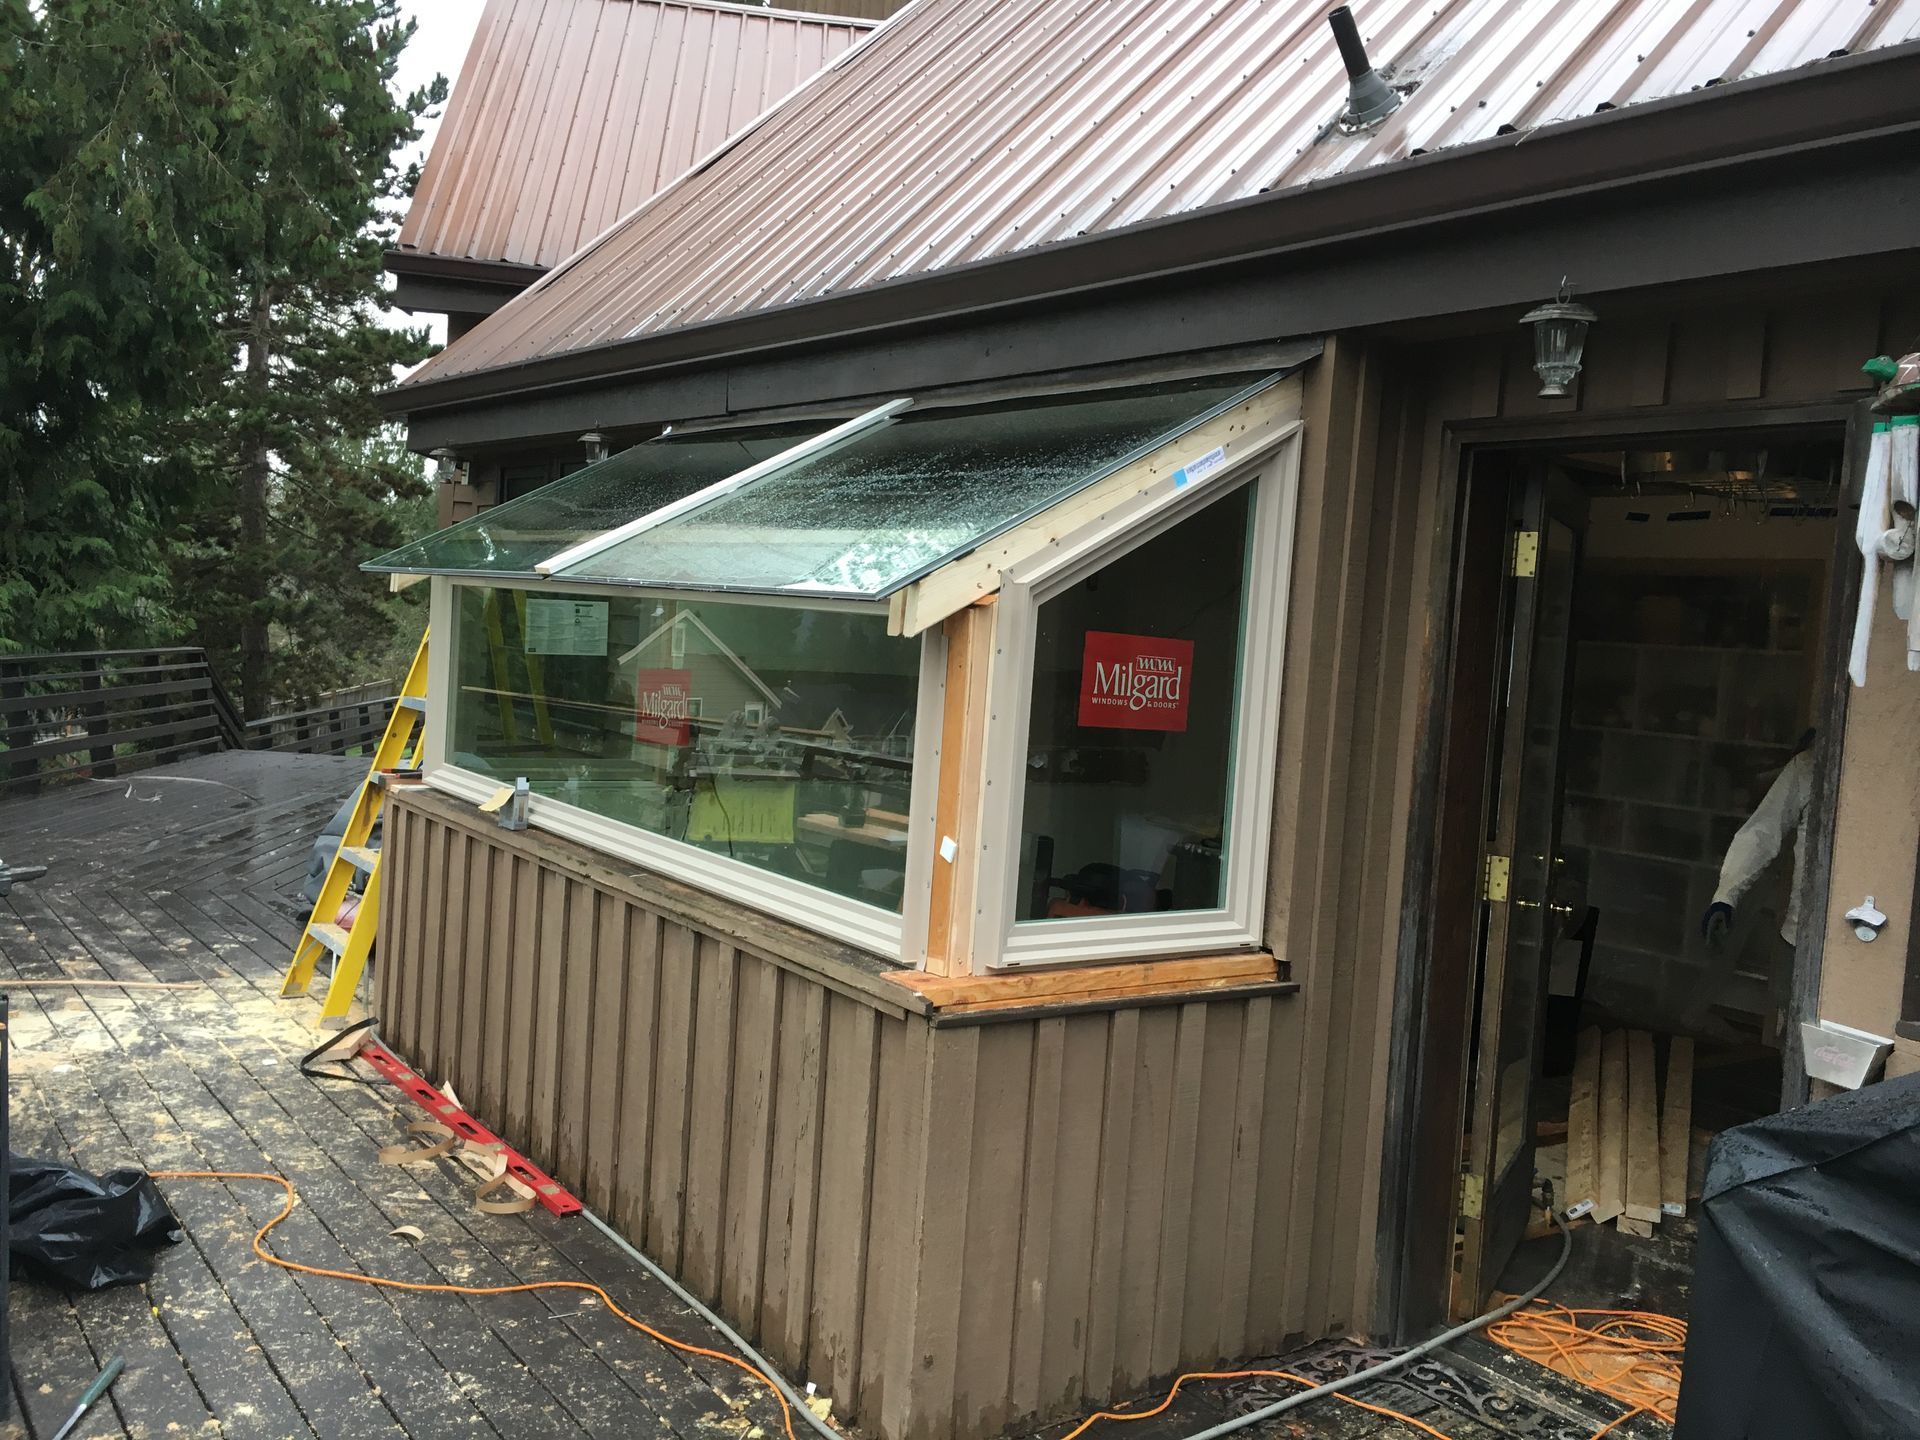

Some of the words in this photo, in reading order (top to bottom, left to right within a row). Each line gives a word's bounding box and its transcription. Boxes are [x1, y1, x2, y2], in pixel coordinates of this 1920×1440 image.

[1092, 697, 1128, 706] WINDOWS
[1093, 662, 1182, 711] Milgard
[642, 690, 686, 729] Milgard
